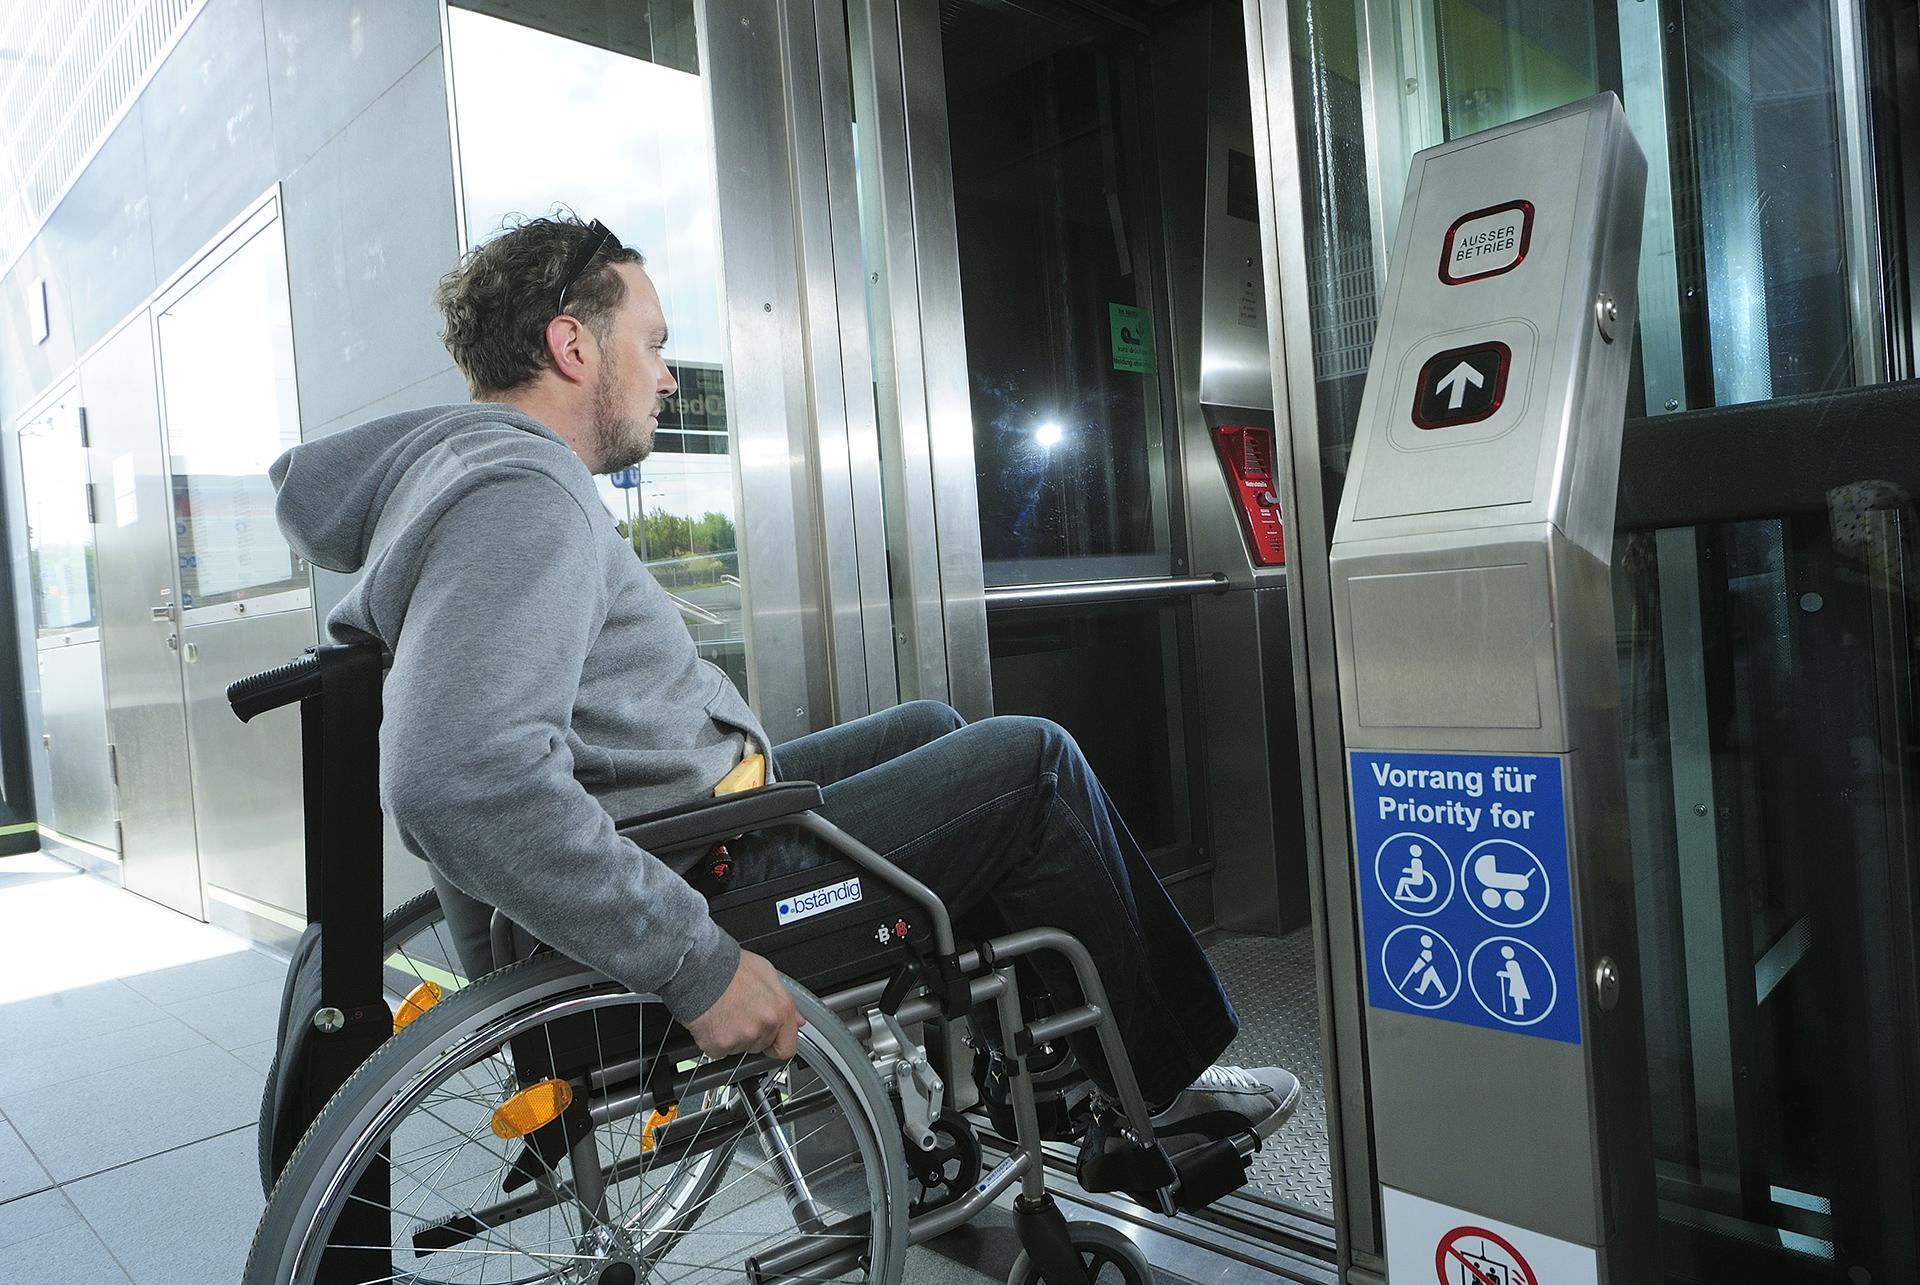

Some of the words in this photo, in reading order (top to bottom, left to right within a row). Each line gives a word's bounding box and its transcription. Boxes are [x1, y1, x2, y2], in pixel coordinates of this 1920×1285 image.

[1456, 238, 1514, 262] BETRIEB
[1461, 226, 1515, 248] AUSSER
[1371, 762, 1483, 797] Vorrang
[1492, 766, 1536, 793] für
[1378, 796, 1481, 832] Priority
[1490, 802, 1534, 829] for
